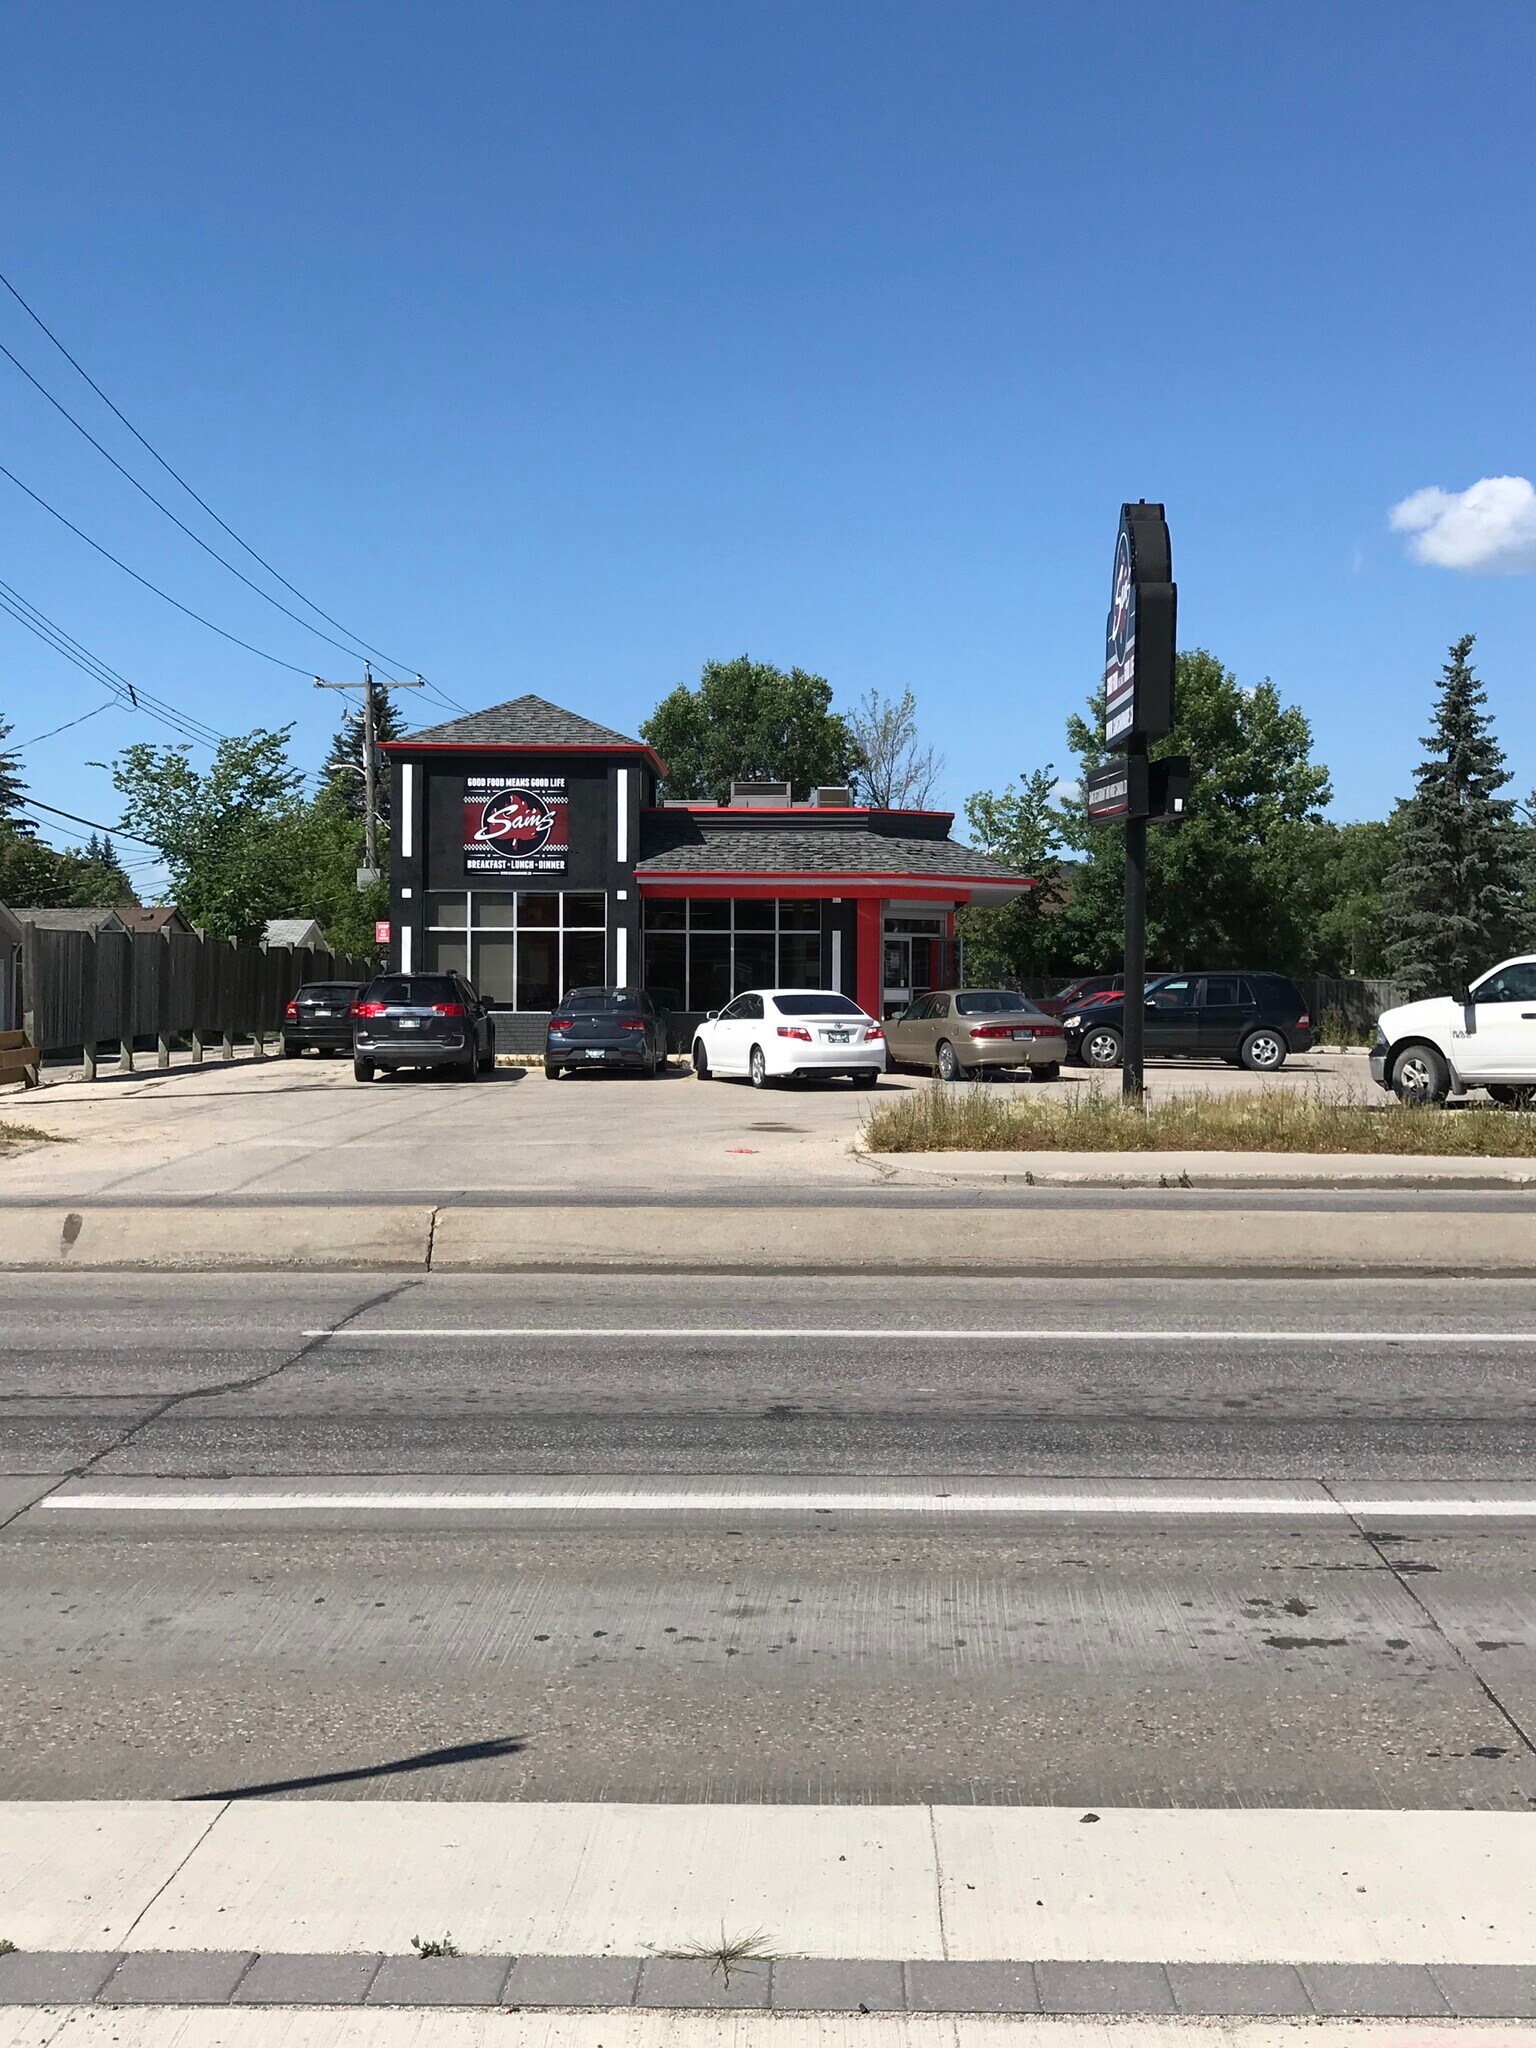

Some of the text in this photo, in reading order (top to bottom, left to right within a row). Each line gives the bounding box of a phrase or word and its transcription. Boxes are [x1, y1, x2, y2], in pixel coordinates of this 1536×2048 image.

[467, 777, 565, 787] GOOD FOOD MEANS GOOD LIFE
[467, 859, 565, 870] BREAKFAST LUNCH DINNER
